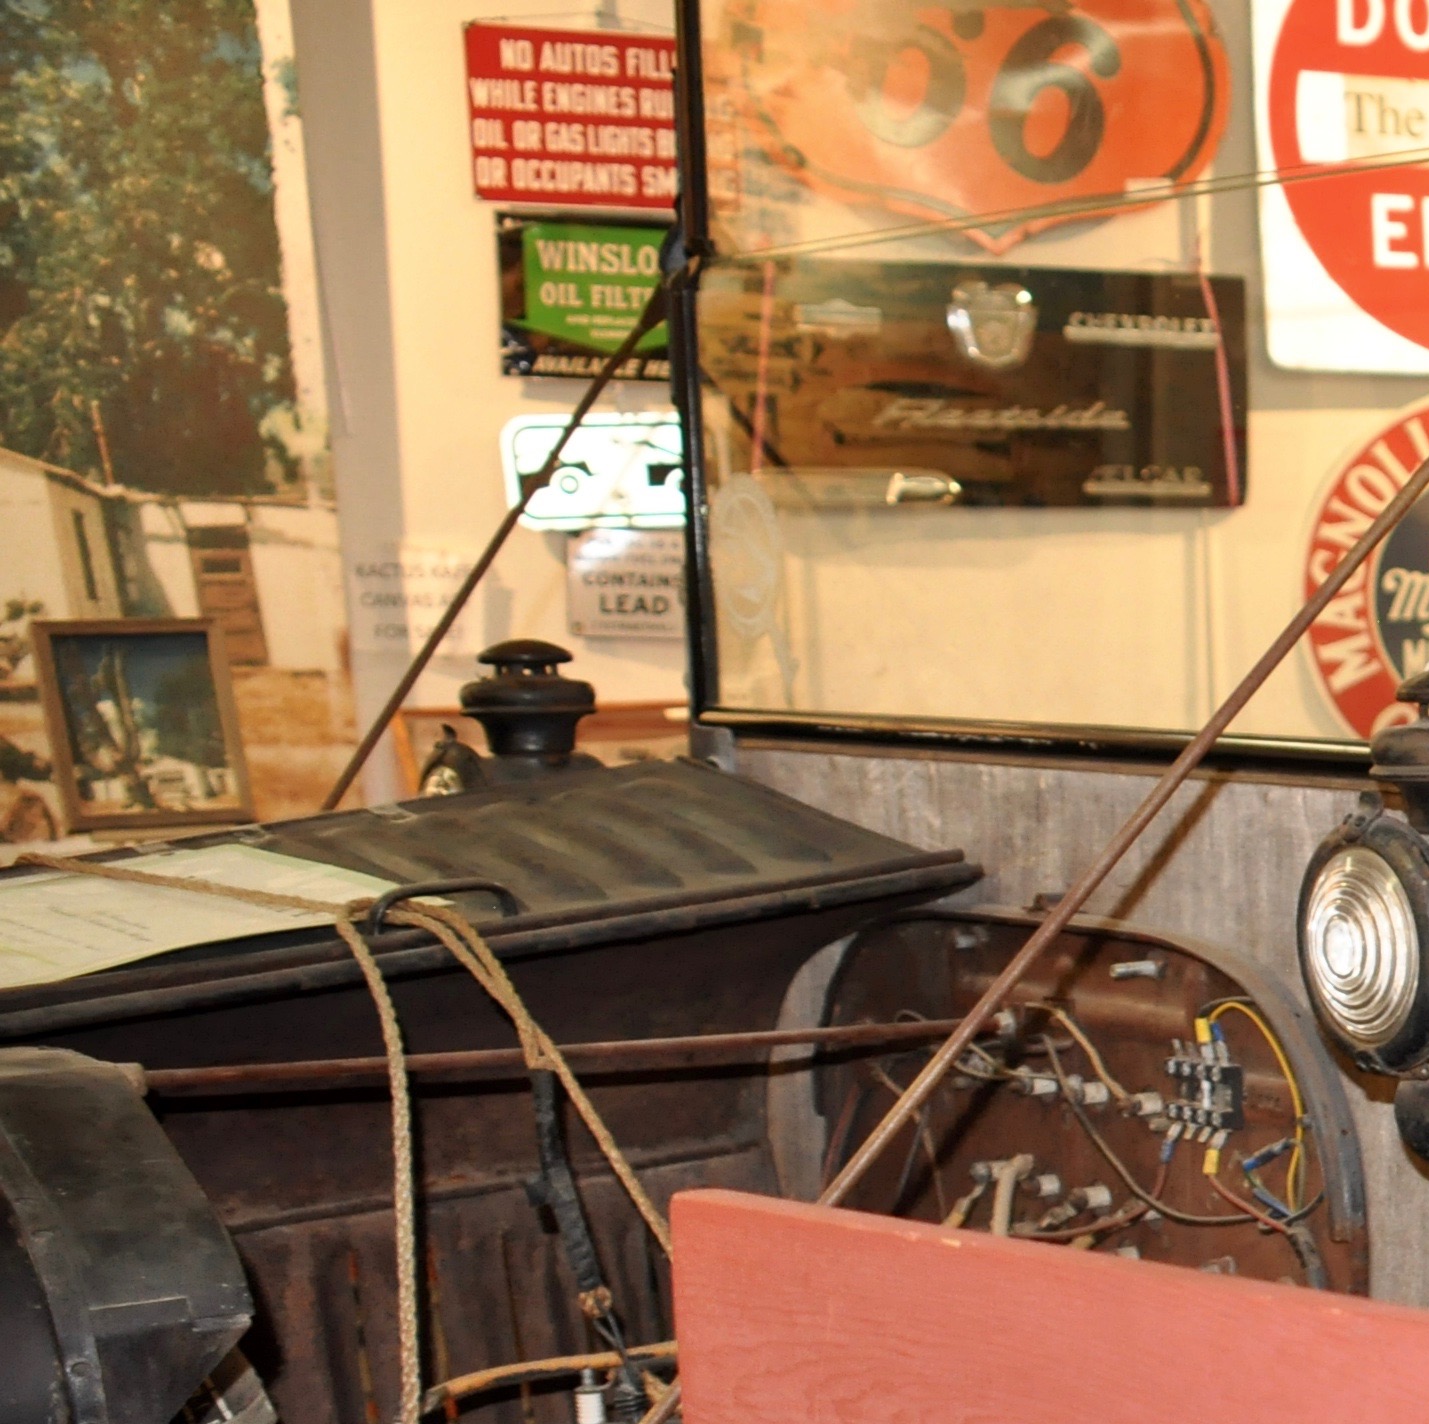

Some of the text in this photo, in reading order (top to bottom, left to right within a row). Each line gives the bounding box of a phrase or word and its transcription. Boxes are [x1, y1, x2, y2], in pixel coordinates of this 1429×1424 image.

[500, 38, 678, 80] NO AUTOS FILL
[469, 77, 538, 112] WHILE
[541, 81, 637, 119] ENGINES
[1344, 91, 1425, 138] The
[472, 117, 508, 150] OIL
[512, 119, 543, 152] OR
[545, 121, 585, 154] GAS
[587, 124, 654, 158] LIGHTS
[475, 155, 508, 189] OR
[511, 157, 638, 197] OCCUPANTS
[536, 239, 660, 276] WINSLO
[540, 281, 655, 309] OIL FILT
[531, 354, 639, 379] AVAILALE
[598, 593, 671, 616] LEAD
